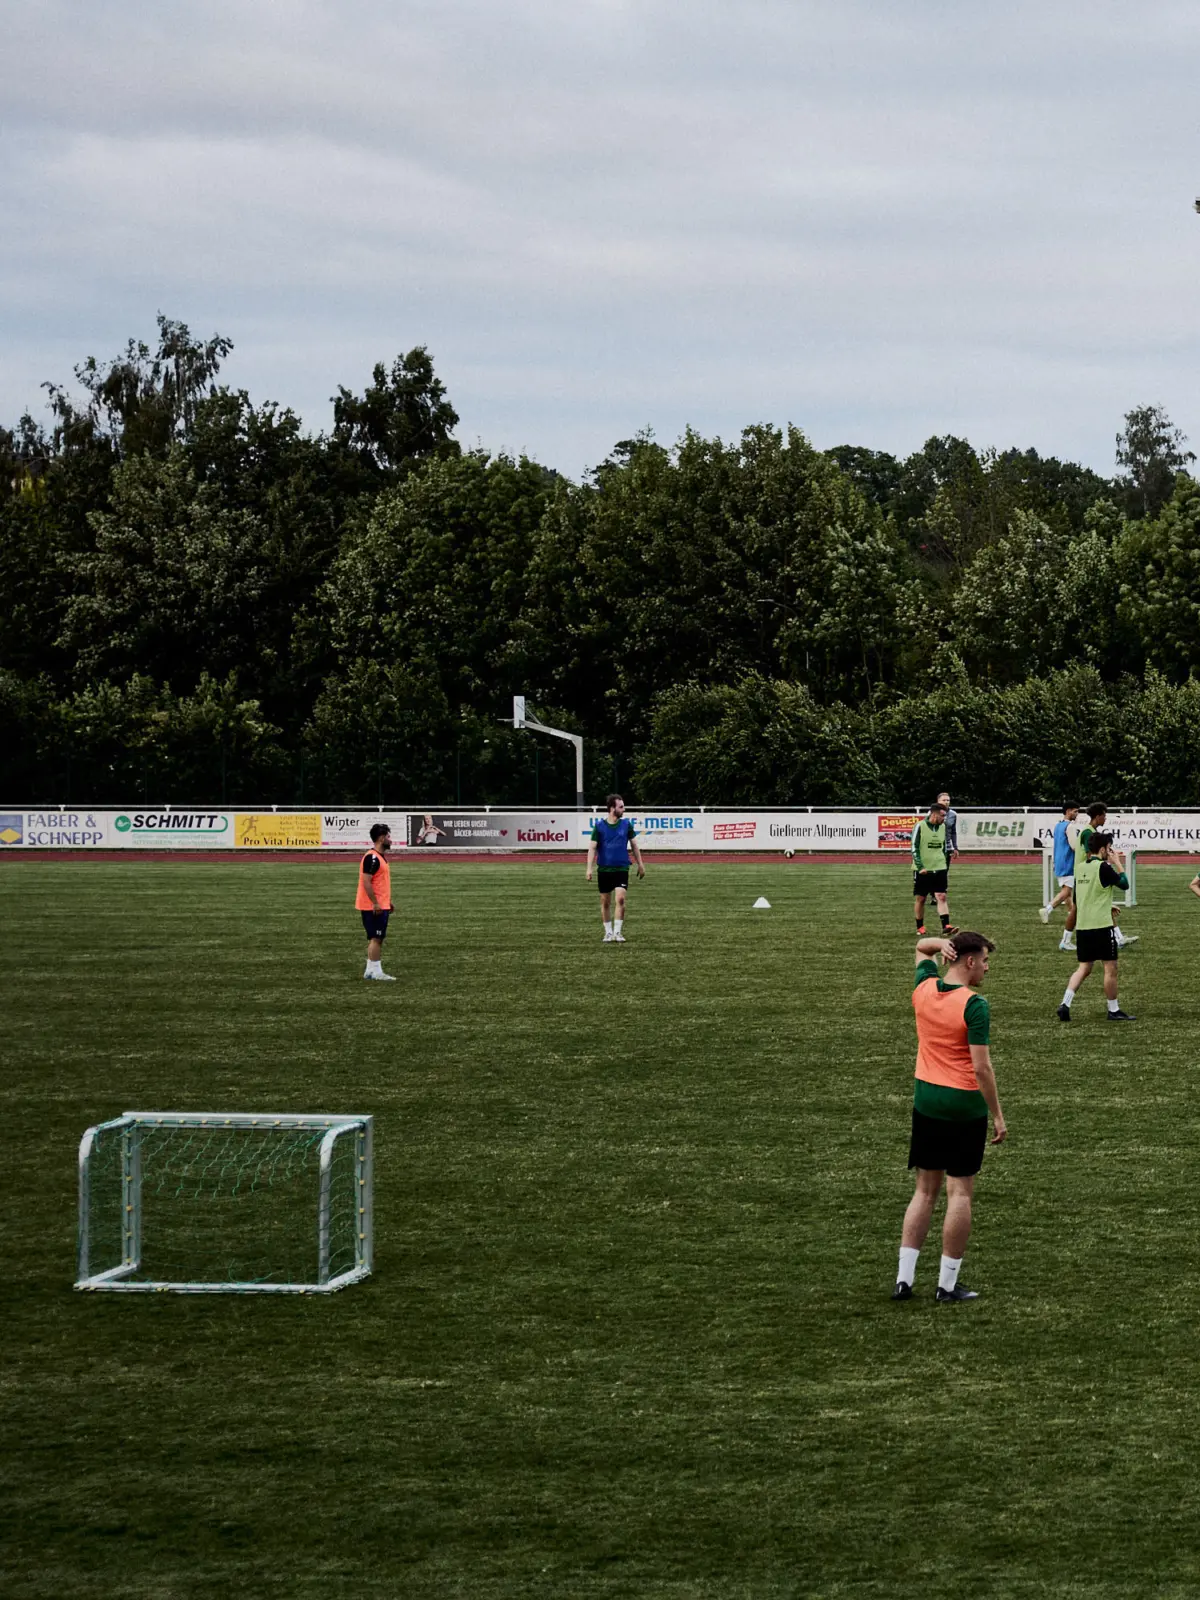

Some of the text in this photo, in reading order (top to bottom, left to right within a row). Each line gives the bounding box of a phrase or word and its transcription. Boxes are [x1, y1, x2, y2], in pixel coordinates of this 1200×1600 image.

[27, 814, 97, 827] FABER &
[132, 814, 218, 828] SCHMITT
[324, 816, 360, 831] Winter
[443, 820, 487, 828] WIR LIEBEN UNSER
[735, 823, 755, 831] Region.
[1153, 816, 1173, 825] Ball
[454, 828, 500, 837] BÄCKER-HANDWERK
[517, 829, 568, 842] künkel
[769, 823, 867, 839] Gießener Allgemeine
[976, 821, 1025, 837] Weil
[27, 832, 103, 845] SCHNEPP
[243, 837, 260, 846] Pro
[263, 837, 282, 846] Vita
[286, 836, 320, 846] Fitness
